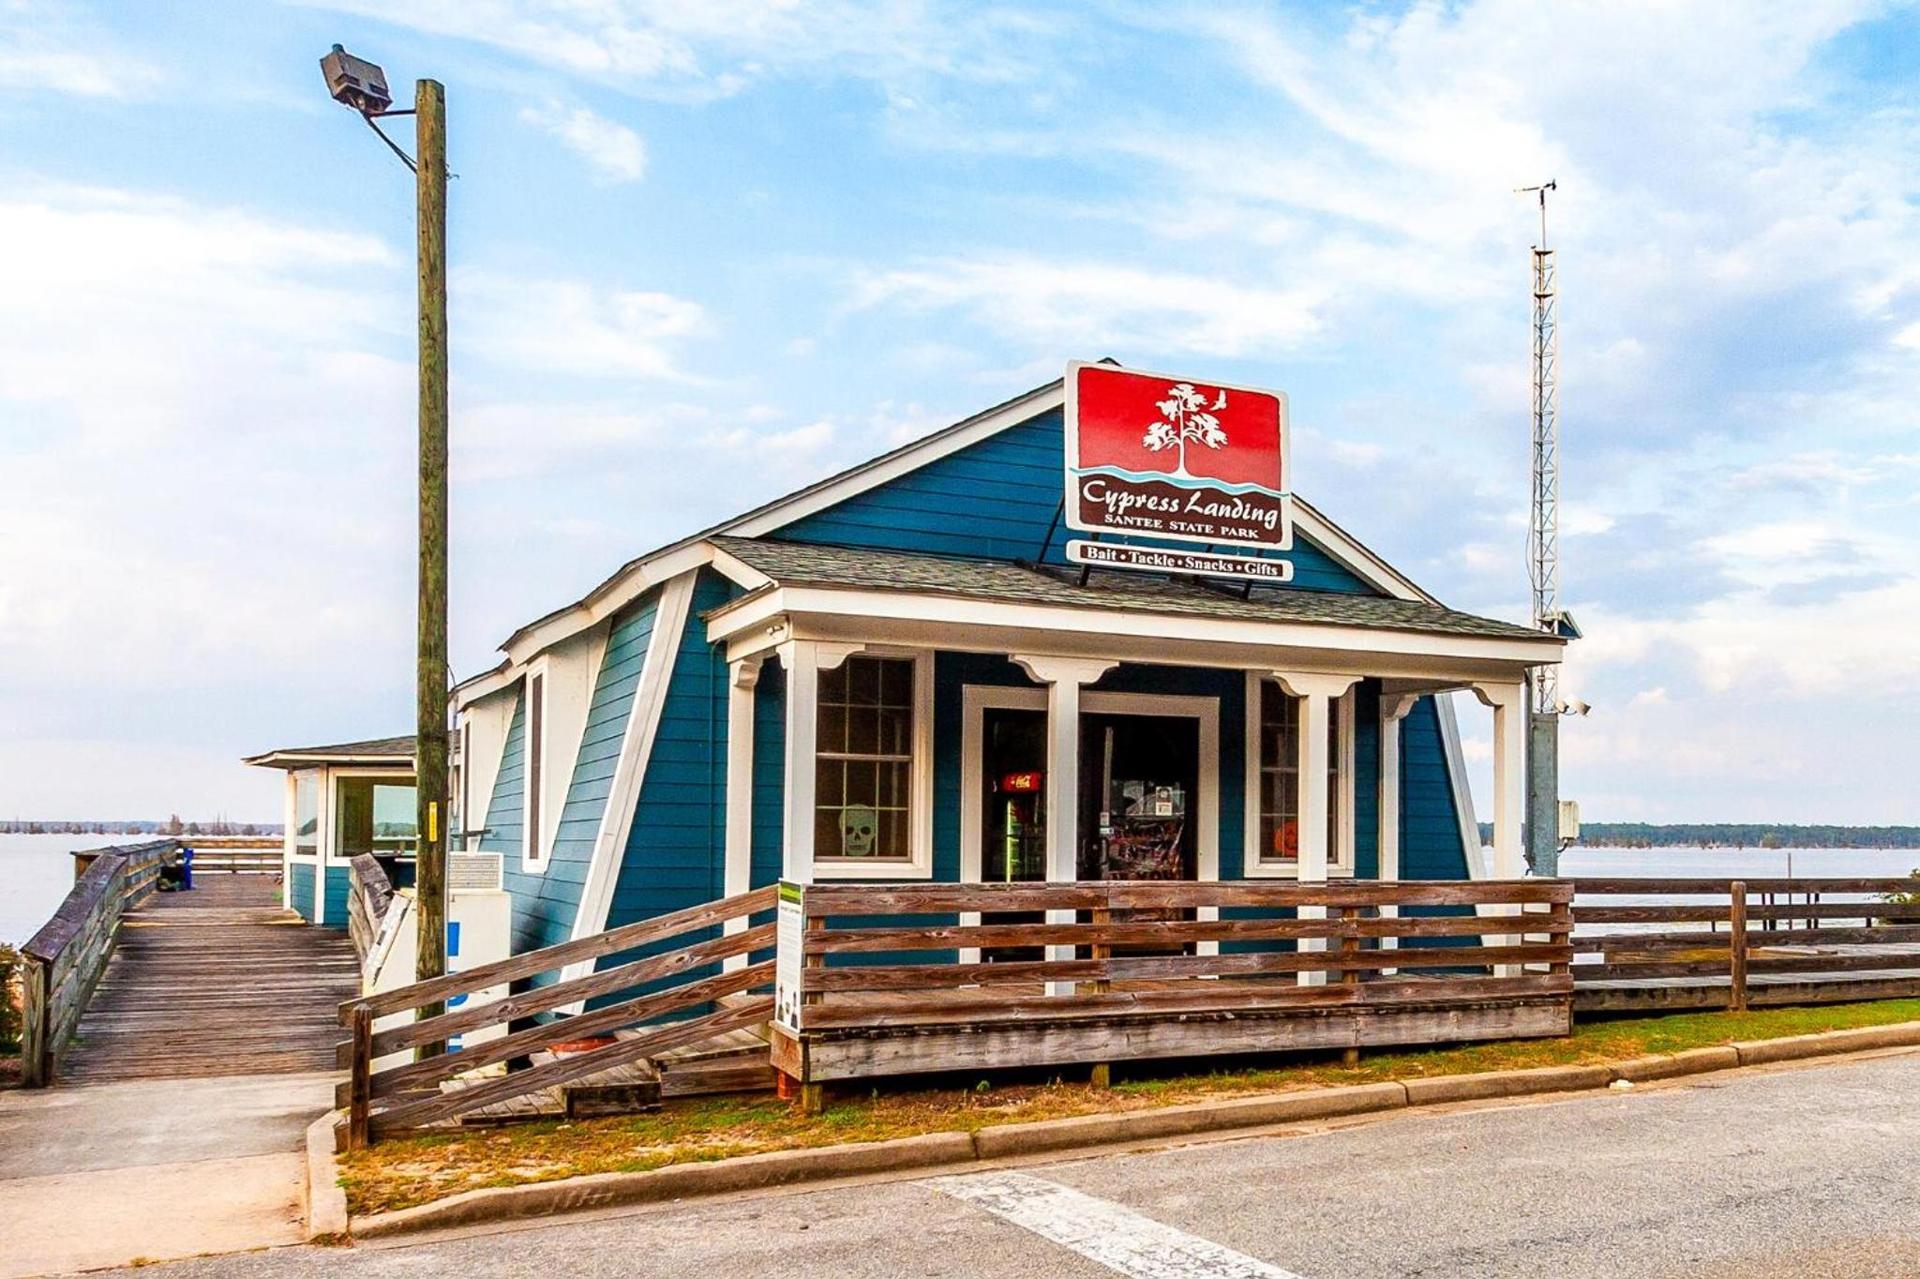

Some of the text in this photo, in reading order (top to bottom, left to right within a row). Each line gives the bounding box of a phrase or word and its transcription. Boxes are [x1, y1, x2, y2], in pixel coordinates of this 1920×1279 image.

[1083, 480, 1279, 531] Cypress Landing
[1104, 513, 1259, 539] SANTEE STATE PARK
[1087, 546, 1278, 576] Bait Tackle Snacks Gifts
